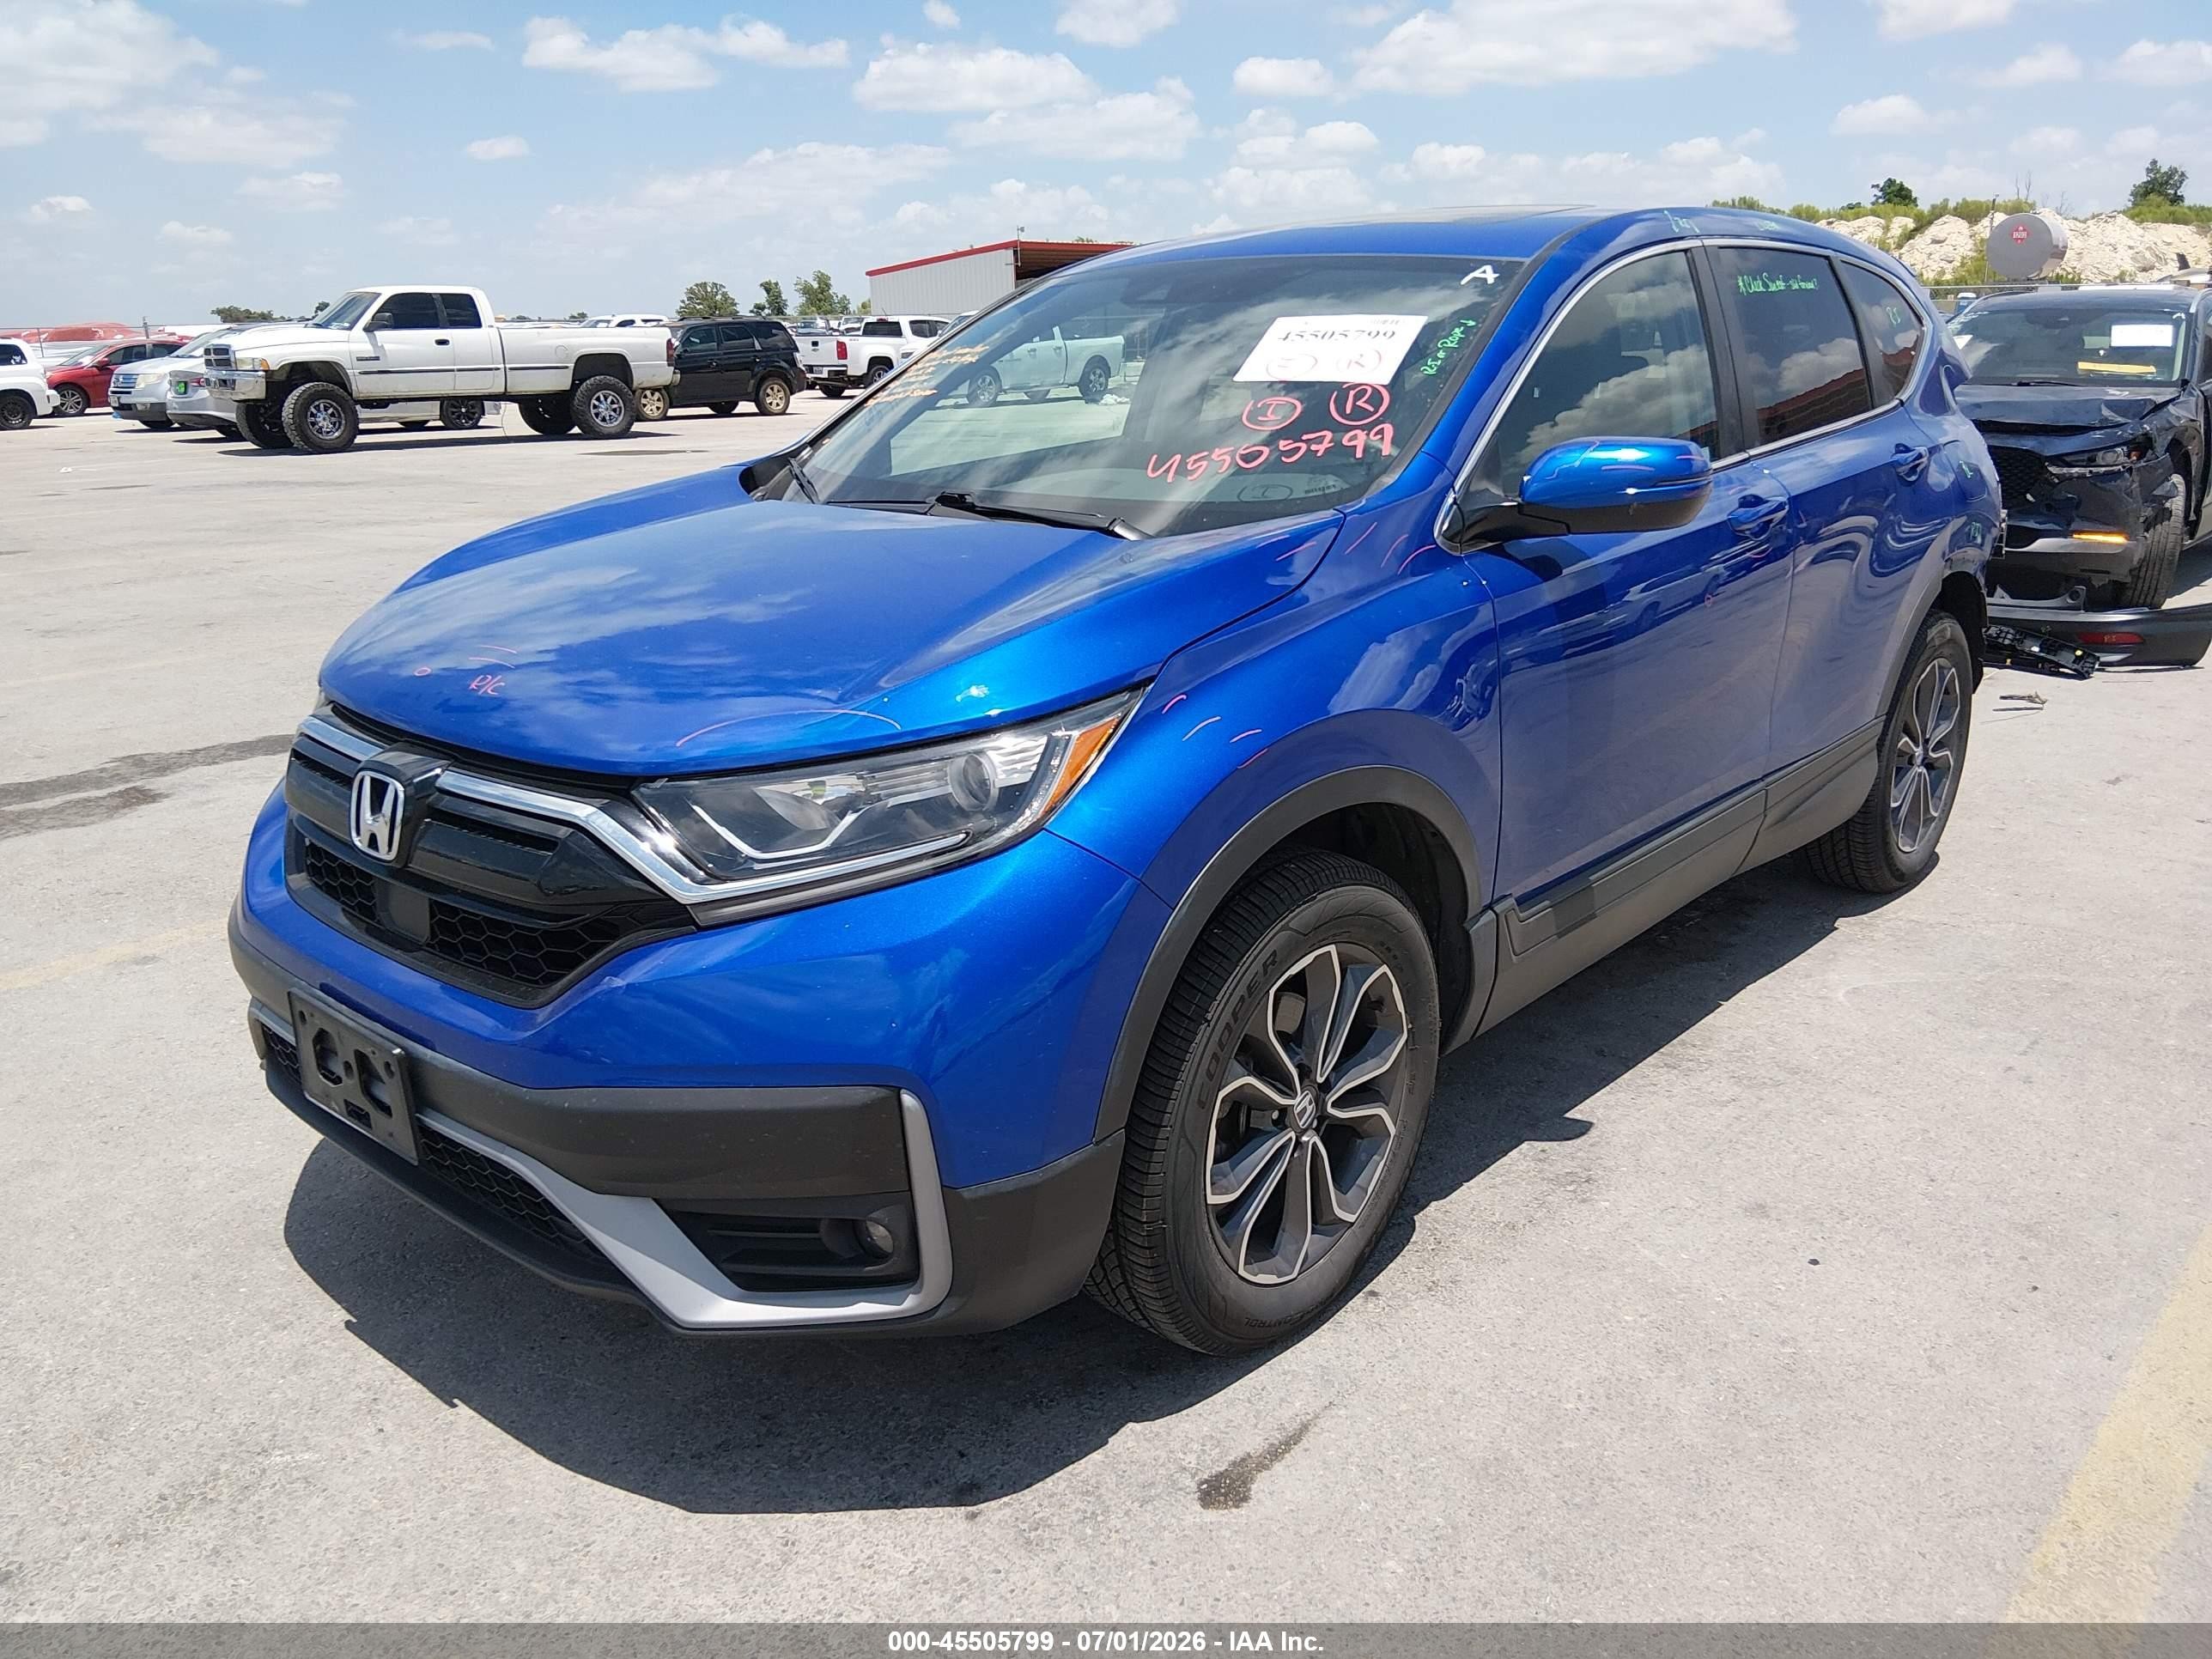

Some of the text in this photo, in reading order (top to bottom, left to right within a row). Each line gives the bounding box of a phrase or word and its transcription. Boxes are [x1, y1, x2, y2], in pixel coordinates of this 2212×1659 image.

[1460, 264, 1500, 284] A
[1146, 422, 1395, 483] 45505799
[1196, 948, 1279, 1109] COOPER
